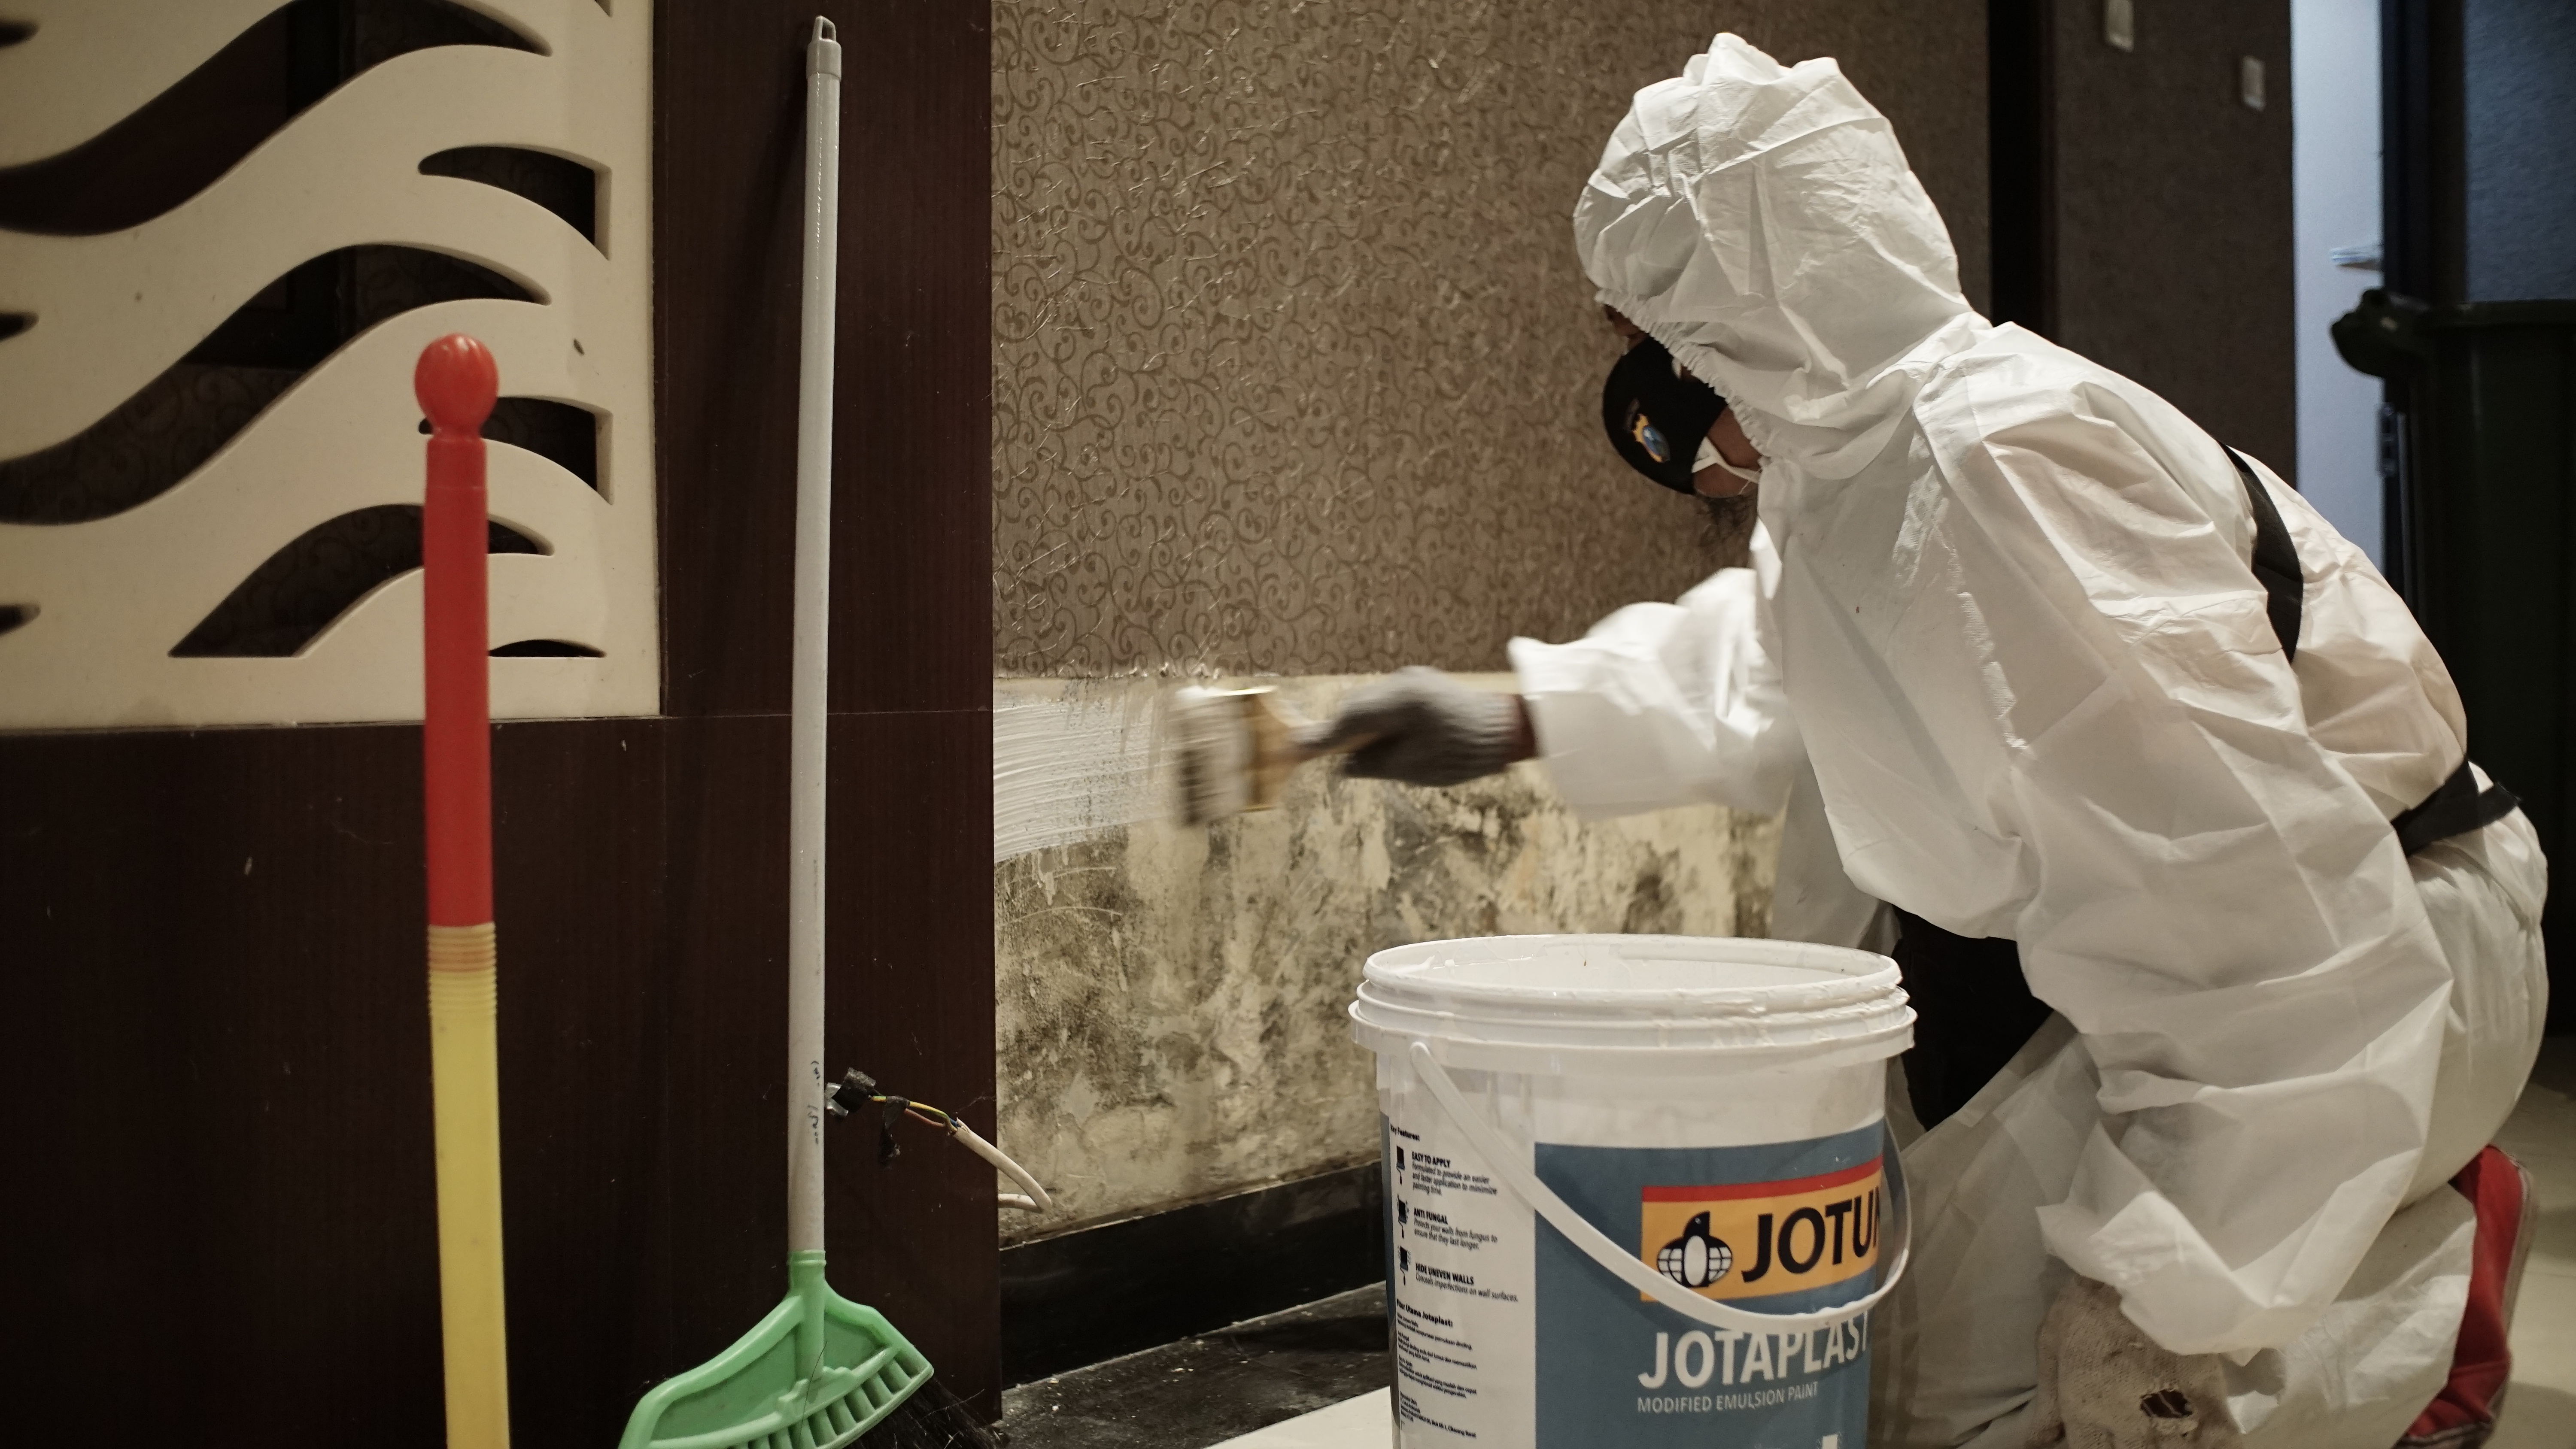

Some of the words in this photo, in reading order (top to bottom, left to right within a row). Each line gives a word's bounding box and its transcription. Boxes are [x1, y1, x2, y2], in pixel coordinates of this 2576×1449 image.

[1412, 1151, 1424, 1163] EASY
[1425, 1155, 1431, 1164] TO
[1433, 1157, 1450, 1168] APPLY
[1414, 1207, 1425, 1219] ANTI
[1426, 1211, 1448, 1224] FUNGAL
[1414, 1218, 1429, 1229] Protects
[1430, 1223, 1440, 1233] your
[1442, 1225, 1454, 1235] walls
[1455, 1227, 1468, 1238] from
[1469, 1229, 1489, 1243] fungus
[1491, 1234, 1498, 1243] to
[1438, 1234, 1449, 1246] they
[1450, 1236, 1459, 1246] last
[1416, 1261, 1427, 1275] HIDE
[1428, 1265, 1451, 1280] UNEVEN
[1452, 1272, 1474, 1285] WALLS
[1416, 1272, 1434, 1286] Conceals
[1434, 1279, 1467, 1294] imperfections
[1469, 1285, 1476, 1295] on
[1478, 1288, 1490, 1298] wall
[1406, 1303, 1421, 1318] Utama
[1637, 1310, 1868, 1389] JOTAPLAST
[1637, 1395, 1712, 1414] MODIFIED
[1716, 1388, 1785, 1411] EMULSION
[1788, 1380, 1819, 1401] PAINT
